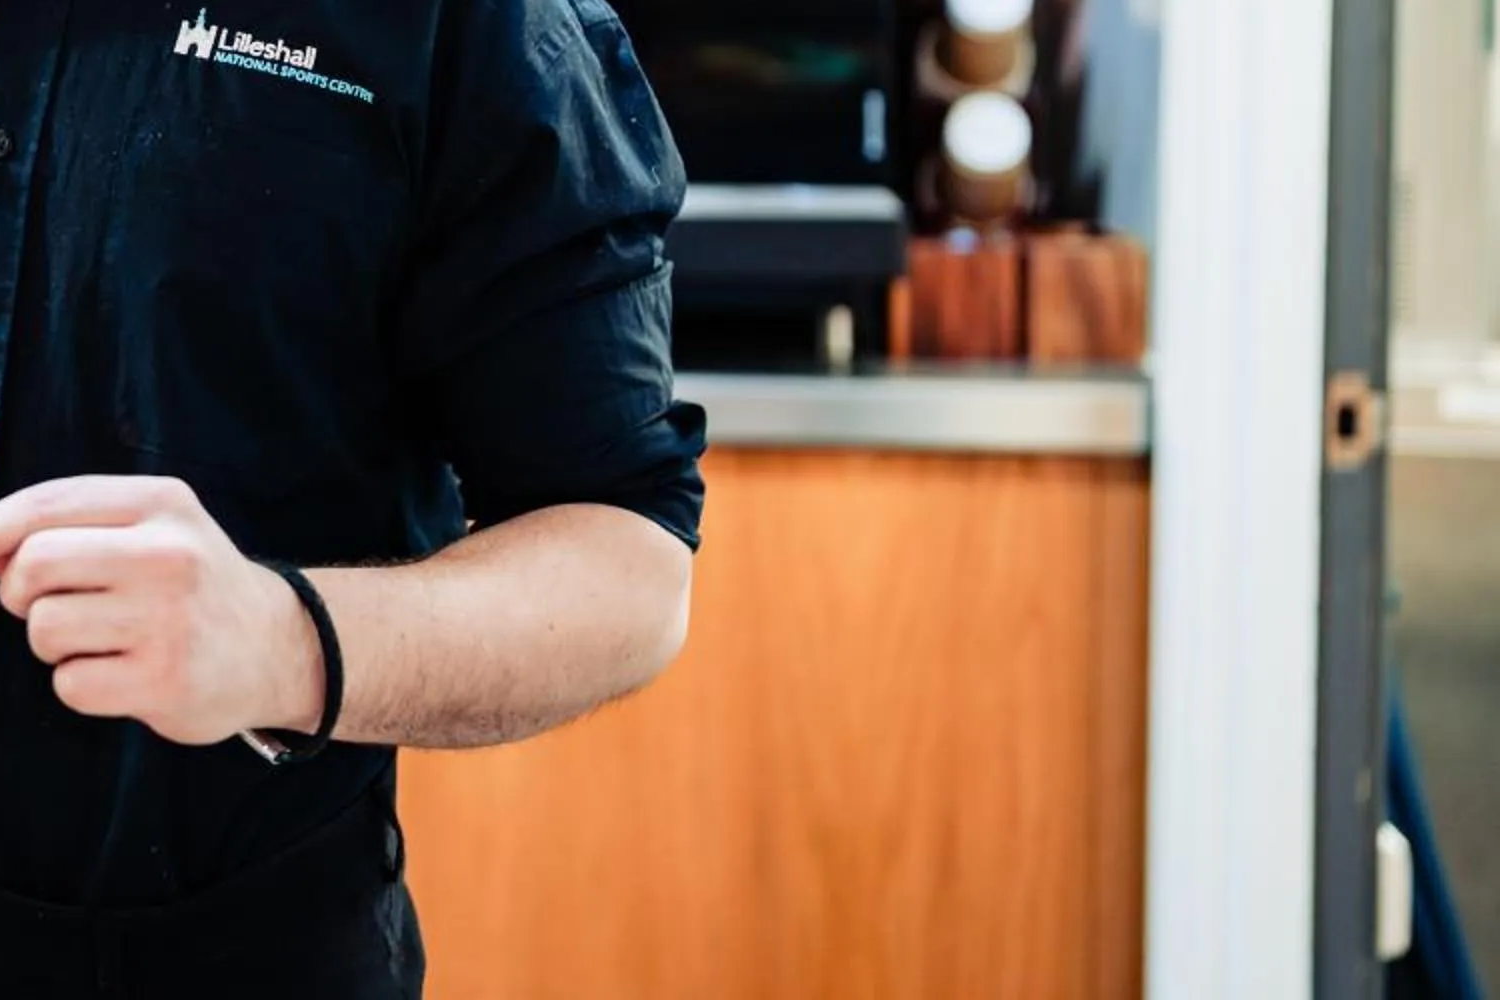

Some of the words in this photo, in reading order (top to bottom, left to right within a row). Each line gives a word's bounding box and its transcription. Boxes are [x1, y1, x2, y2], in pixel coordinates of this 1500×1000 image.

[218, 28, 317, 70] Lilleshall
[214, 51, 280, 76] NATIONAL
[280, 65, 329, 89] SPORTS
[329, 79, 375, 104] CENTRE
